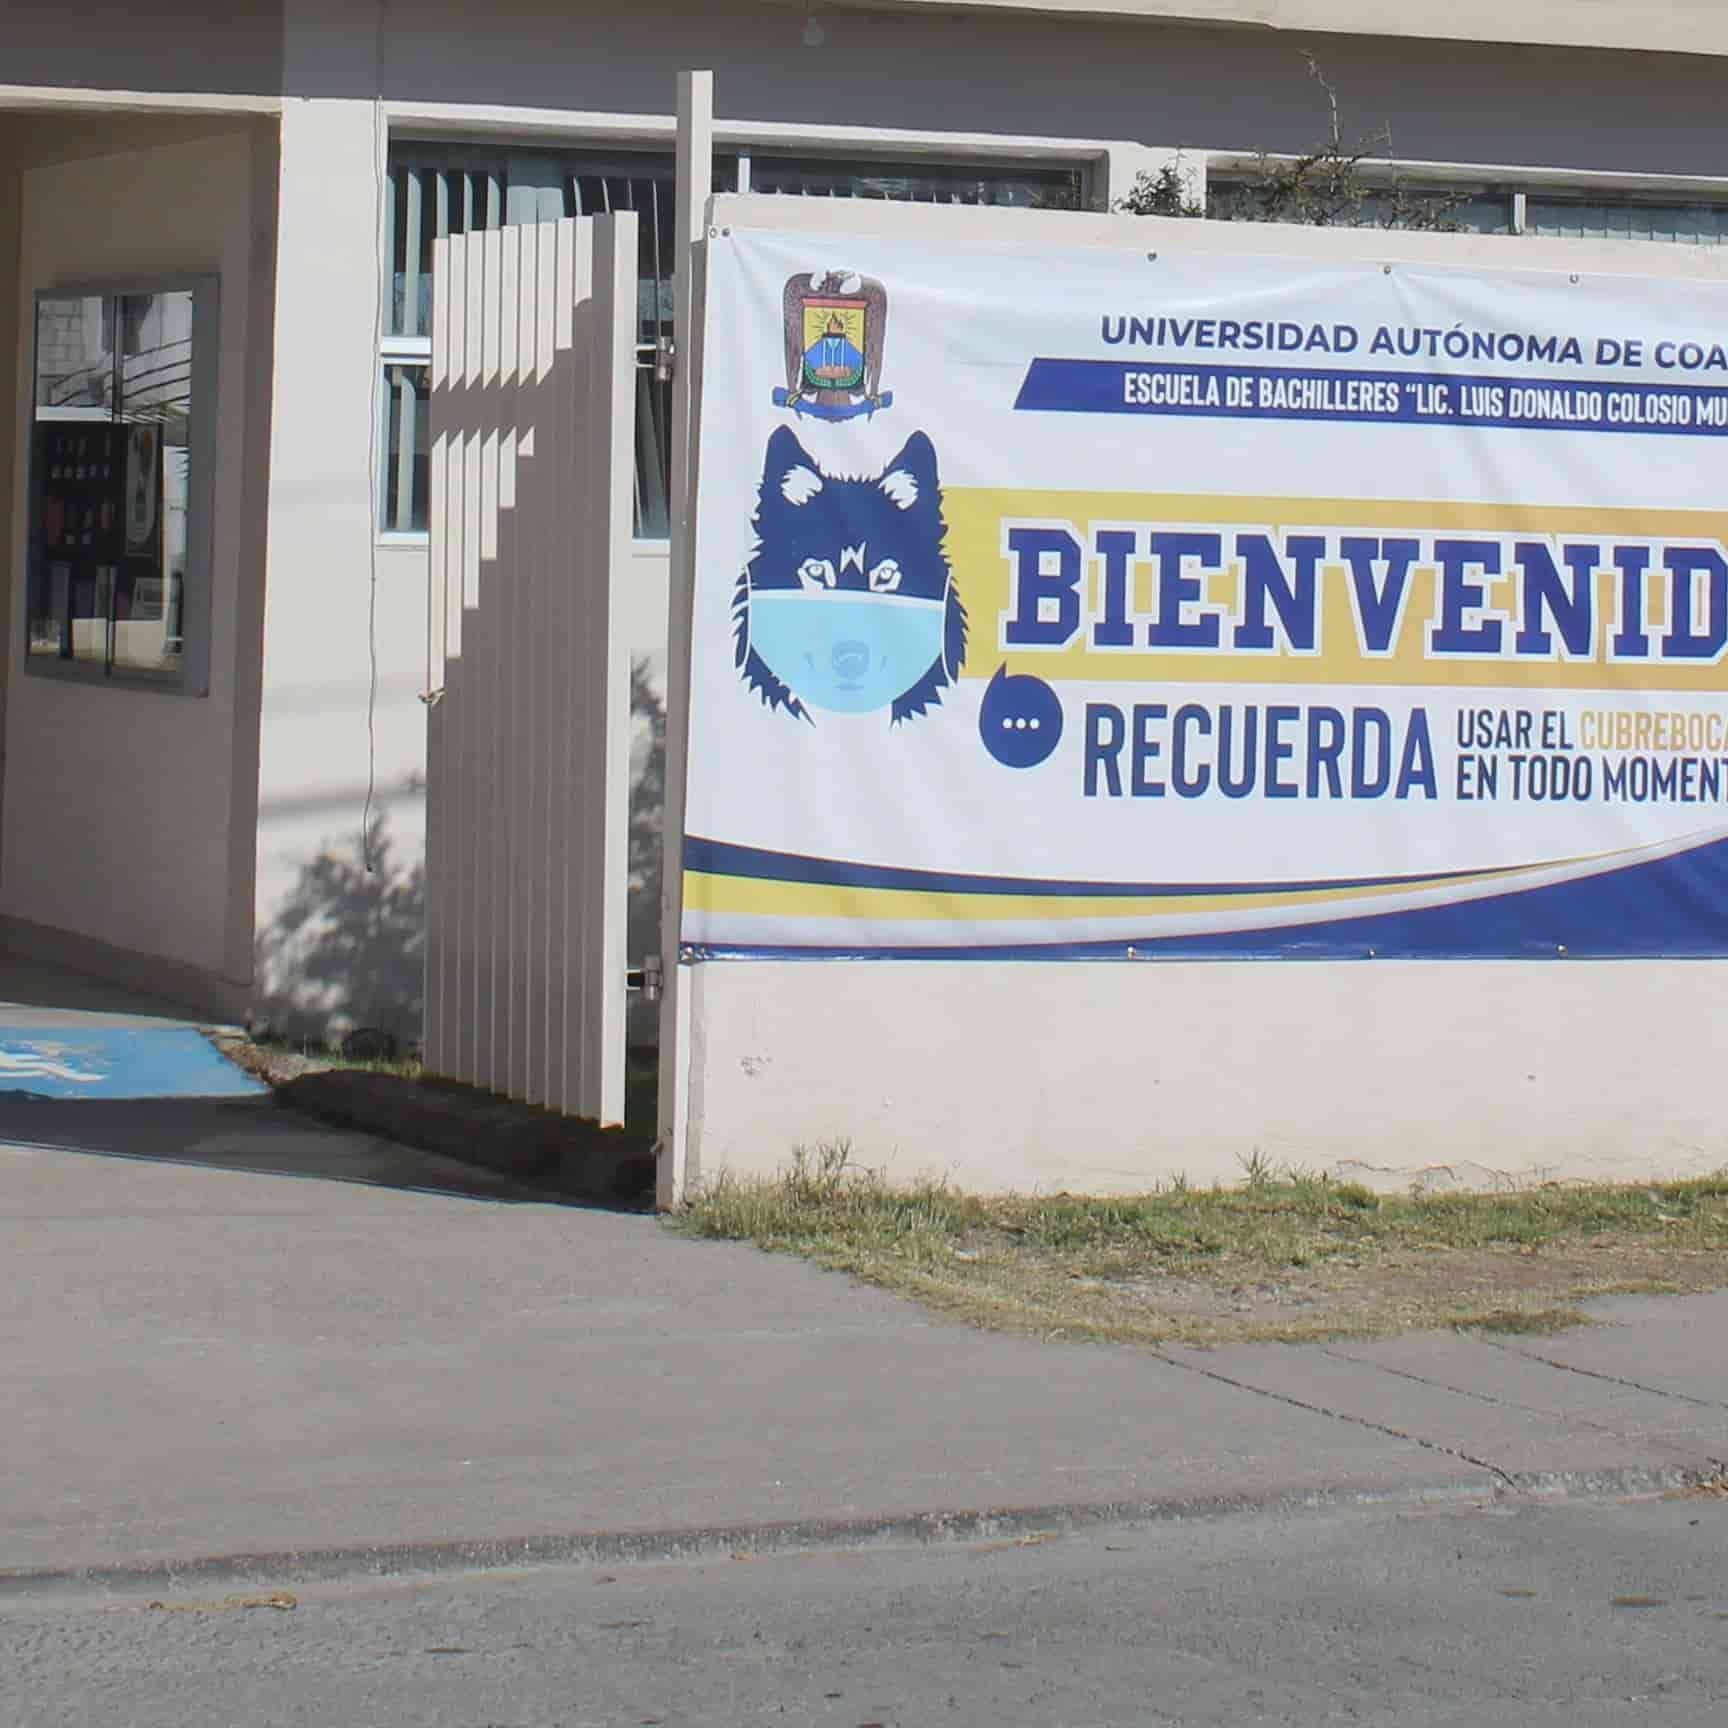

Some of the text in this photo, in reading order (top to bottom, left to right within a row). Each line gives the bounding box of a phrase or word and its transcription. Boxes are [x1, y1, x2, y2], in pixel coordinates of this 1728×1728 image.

[1100, 314, 1359, 354] UNIVERSIDAD
[1368, 321, 1584, 366] AUTÓNOMA
[1594, 337, 1643, 368] DE
[1123, 372, 1221, 408] ESCUELA
[1225, 375, 1254, 409] DE
[1258, 377, 1400, 414] BACHILLERES
[1459, 384, 1505, 418] LUIS
[1507, 386, 1602, 423] DONALDO
[1605, 390, 1691, 426] COLOSIO
[1082, 701, 1439, 800] RECUERDA
[1456, 709, 1533, 751] USAR
[1541, 710, 1574, 752] EL
[1455, 753, 1498, 802] EN
[1507, 755, 1593, 803] TODO
